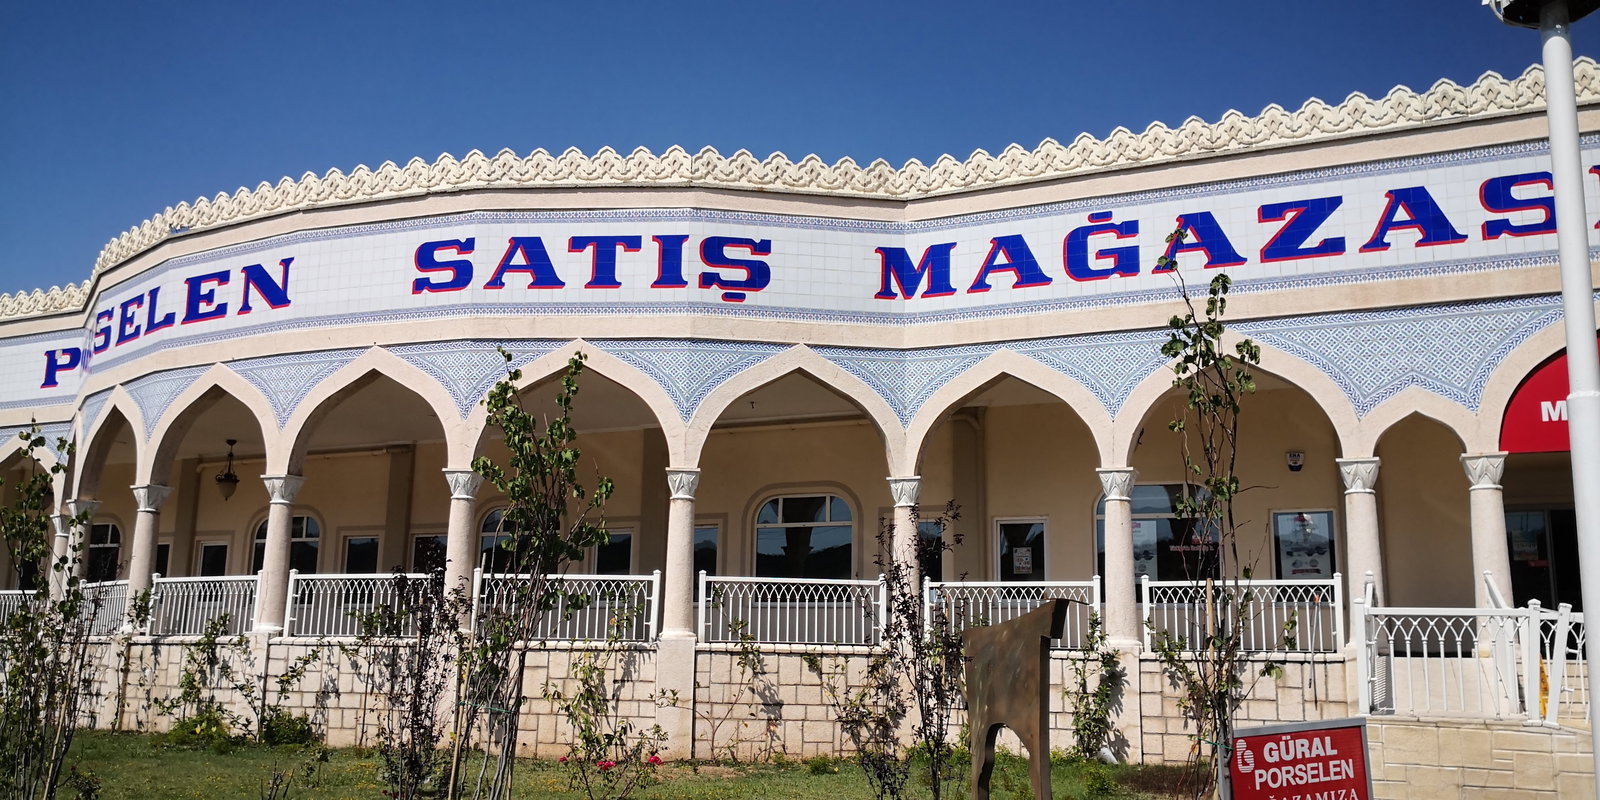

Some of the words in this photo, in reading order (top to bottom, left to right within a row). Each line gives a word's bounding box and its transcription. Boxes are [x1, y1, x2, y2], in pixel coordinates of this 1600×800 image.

[40, 256, 295, 389] PSELEN
[412, 234, 772, 302] SATIŞ
[874, 165, 1600, 300] MAĞAZAS
[1263, 735, 1338, 764] GÜRAL
[1254, 758, 1354, 790] PORSELEN
